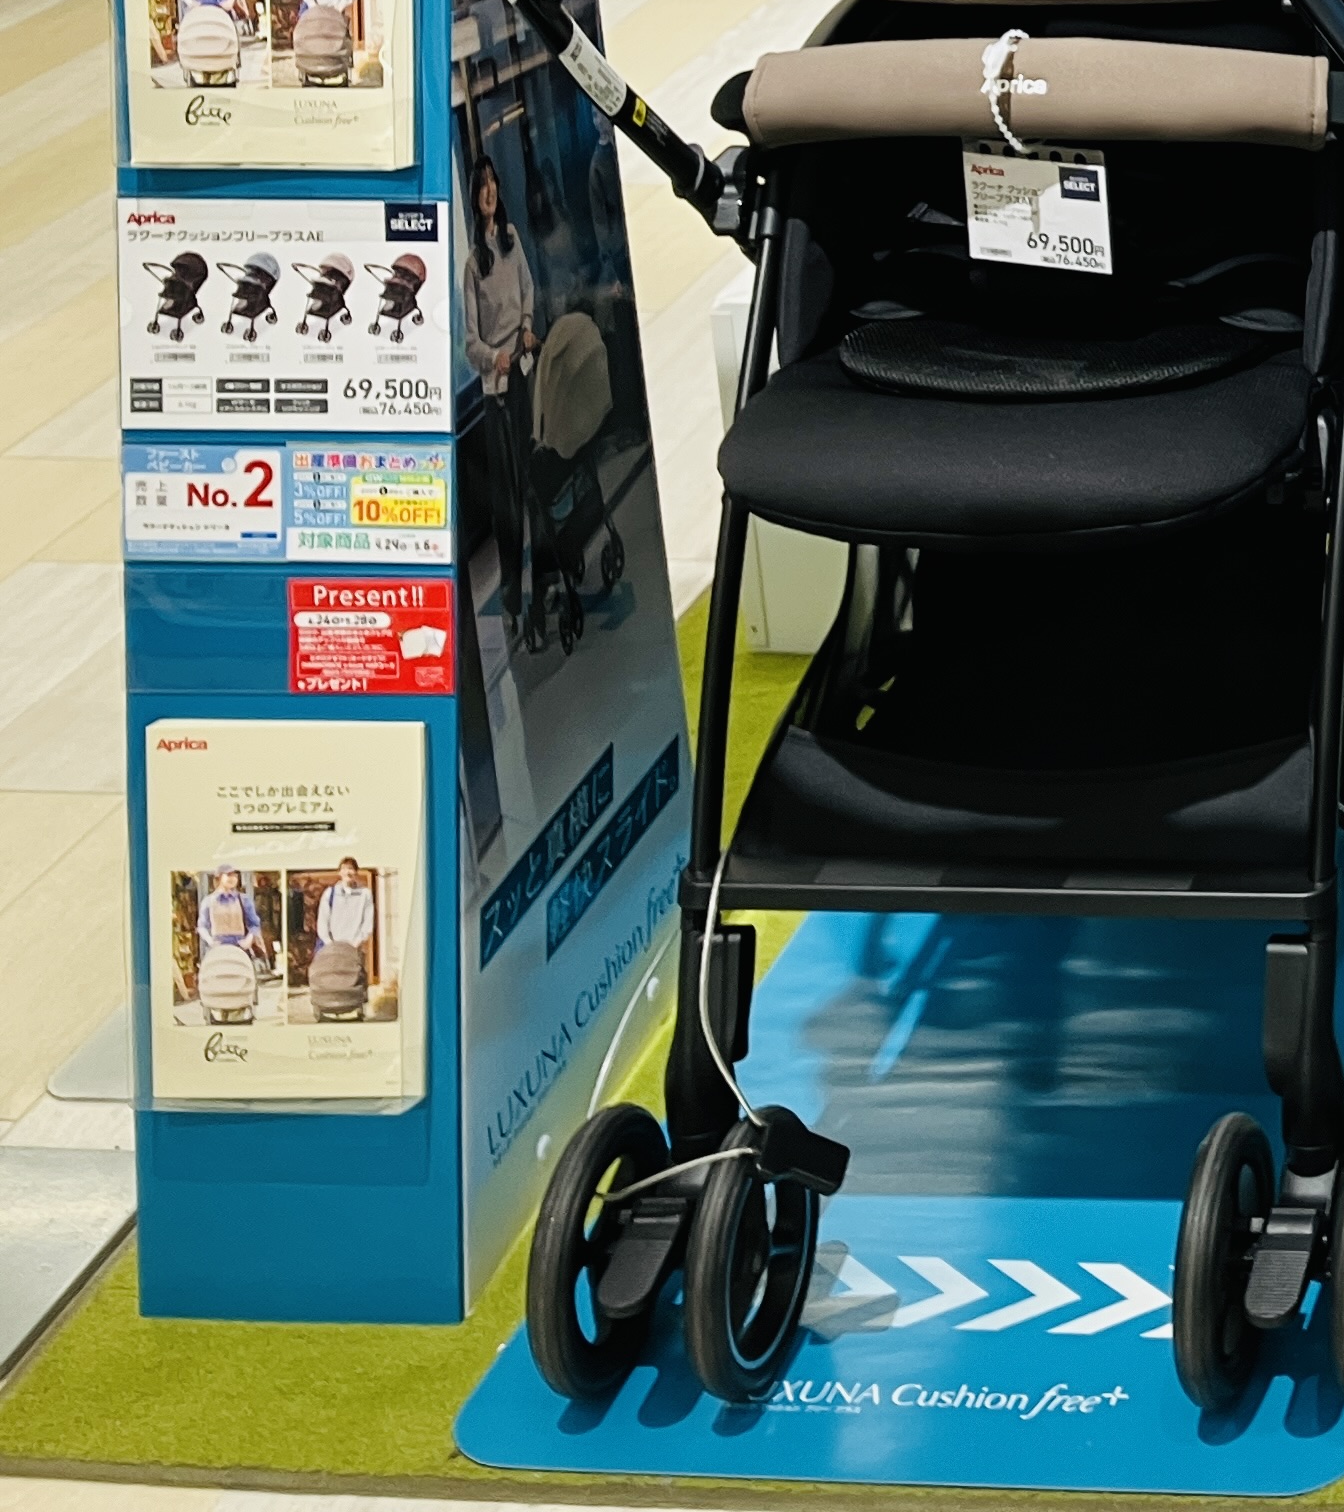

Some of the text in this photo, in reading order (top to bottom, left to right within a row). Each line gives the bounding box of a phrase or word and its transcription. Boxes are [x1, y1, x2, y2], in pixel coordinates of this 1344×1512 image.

[127, 211, 176, 226] Aprica
[1026, 231, 1106, 258] 69,500円
[342, 377, 443, 401] 69,500円
[186, 459, 274, 508] No.2
[353, 499, 442, 524] 10%OFF!
[312, 584, 425, 608] Present!!
[156, 736, 209, 753] Aprica
[891, 1382, 1028, 1411] Cushion
